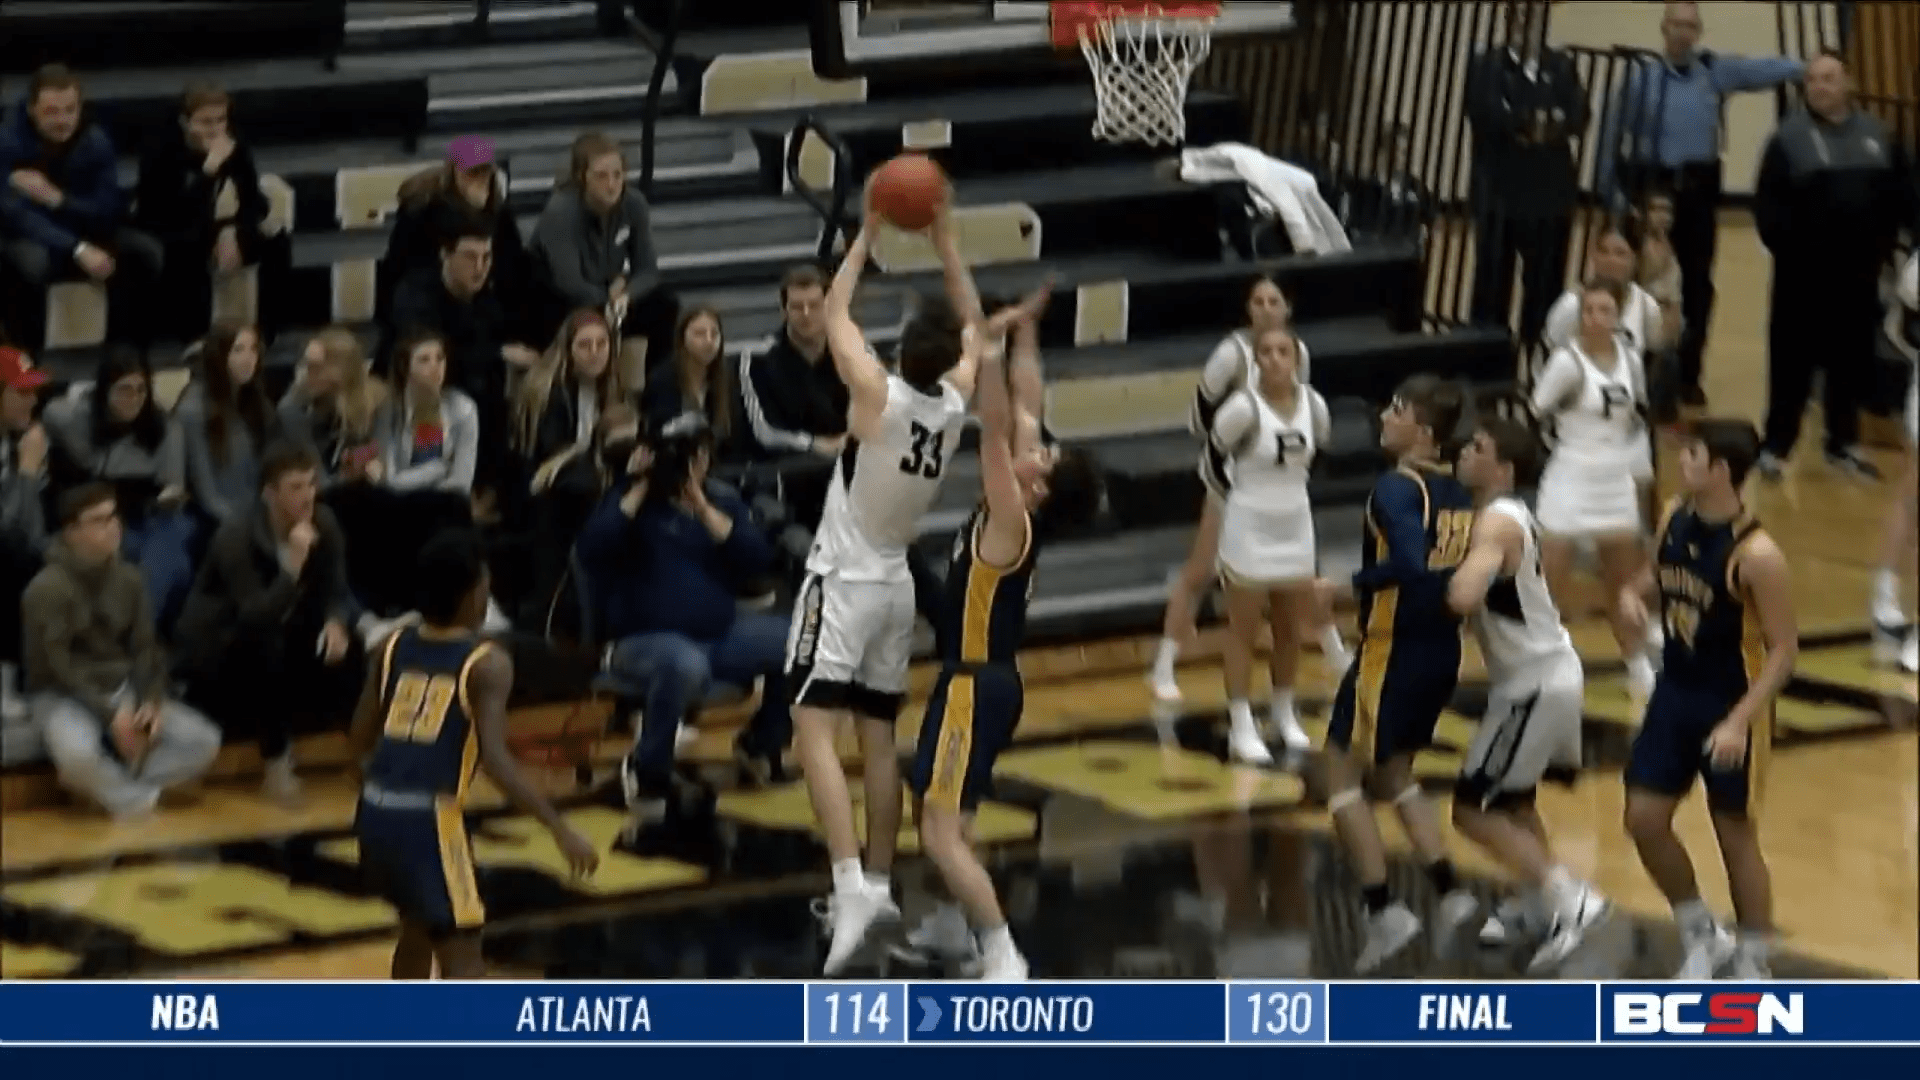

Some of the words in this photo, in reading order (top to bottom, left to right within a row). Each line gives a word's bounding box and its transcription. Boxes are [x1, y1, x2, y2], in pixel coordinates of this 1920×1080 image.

[1600, 383, 1631, 420] P
[899, 420, 945, 479] 33
[1274, 429, 1307, 468] P
